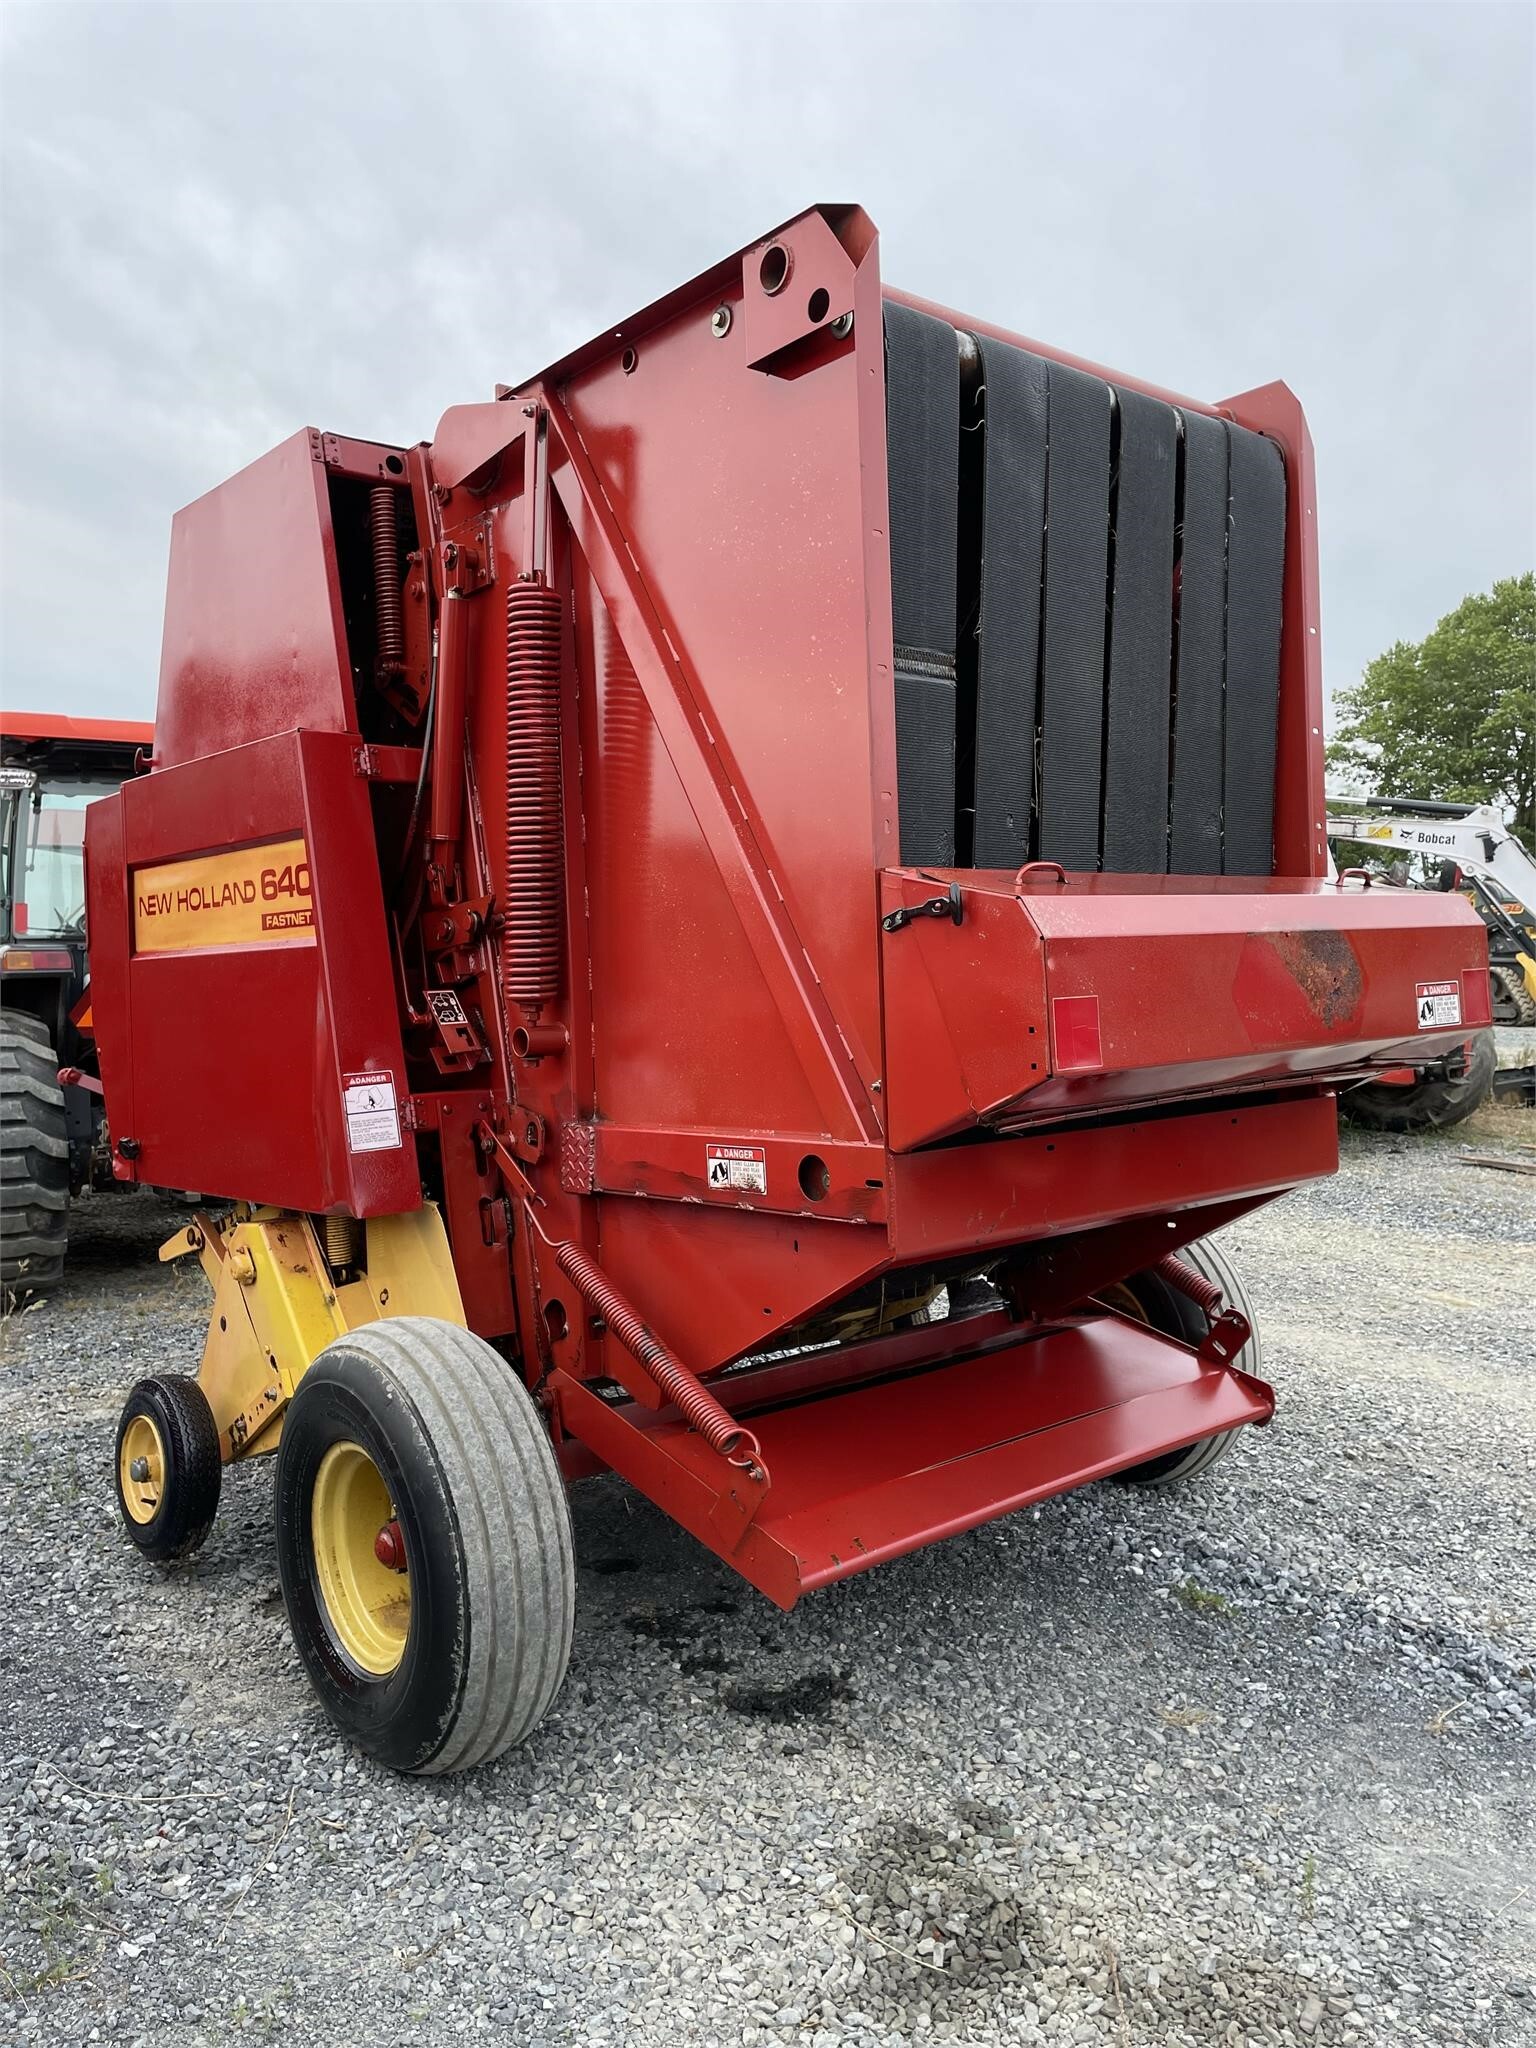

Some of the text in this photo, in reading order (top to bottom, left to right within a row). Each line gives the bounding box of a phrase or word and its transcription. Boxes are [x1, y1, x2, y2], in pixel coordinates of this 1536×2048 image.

[1417, 832, 1456, 845] Bobcat
[139, 863, 313, 918] NEW HOLLAND 640
[266, 911, 312, 929] FASTNET
[1429, 985, 1452, 995] DANGER
[356, 1075, 387, 1084] DANGER
[724, 1149, 754, 1159] DANGER
